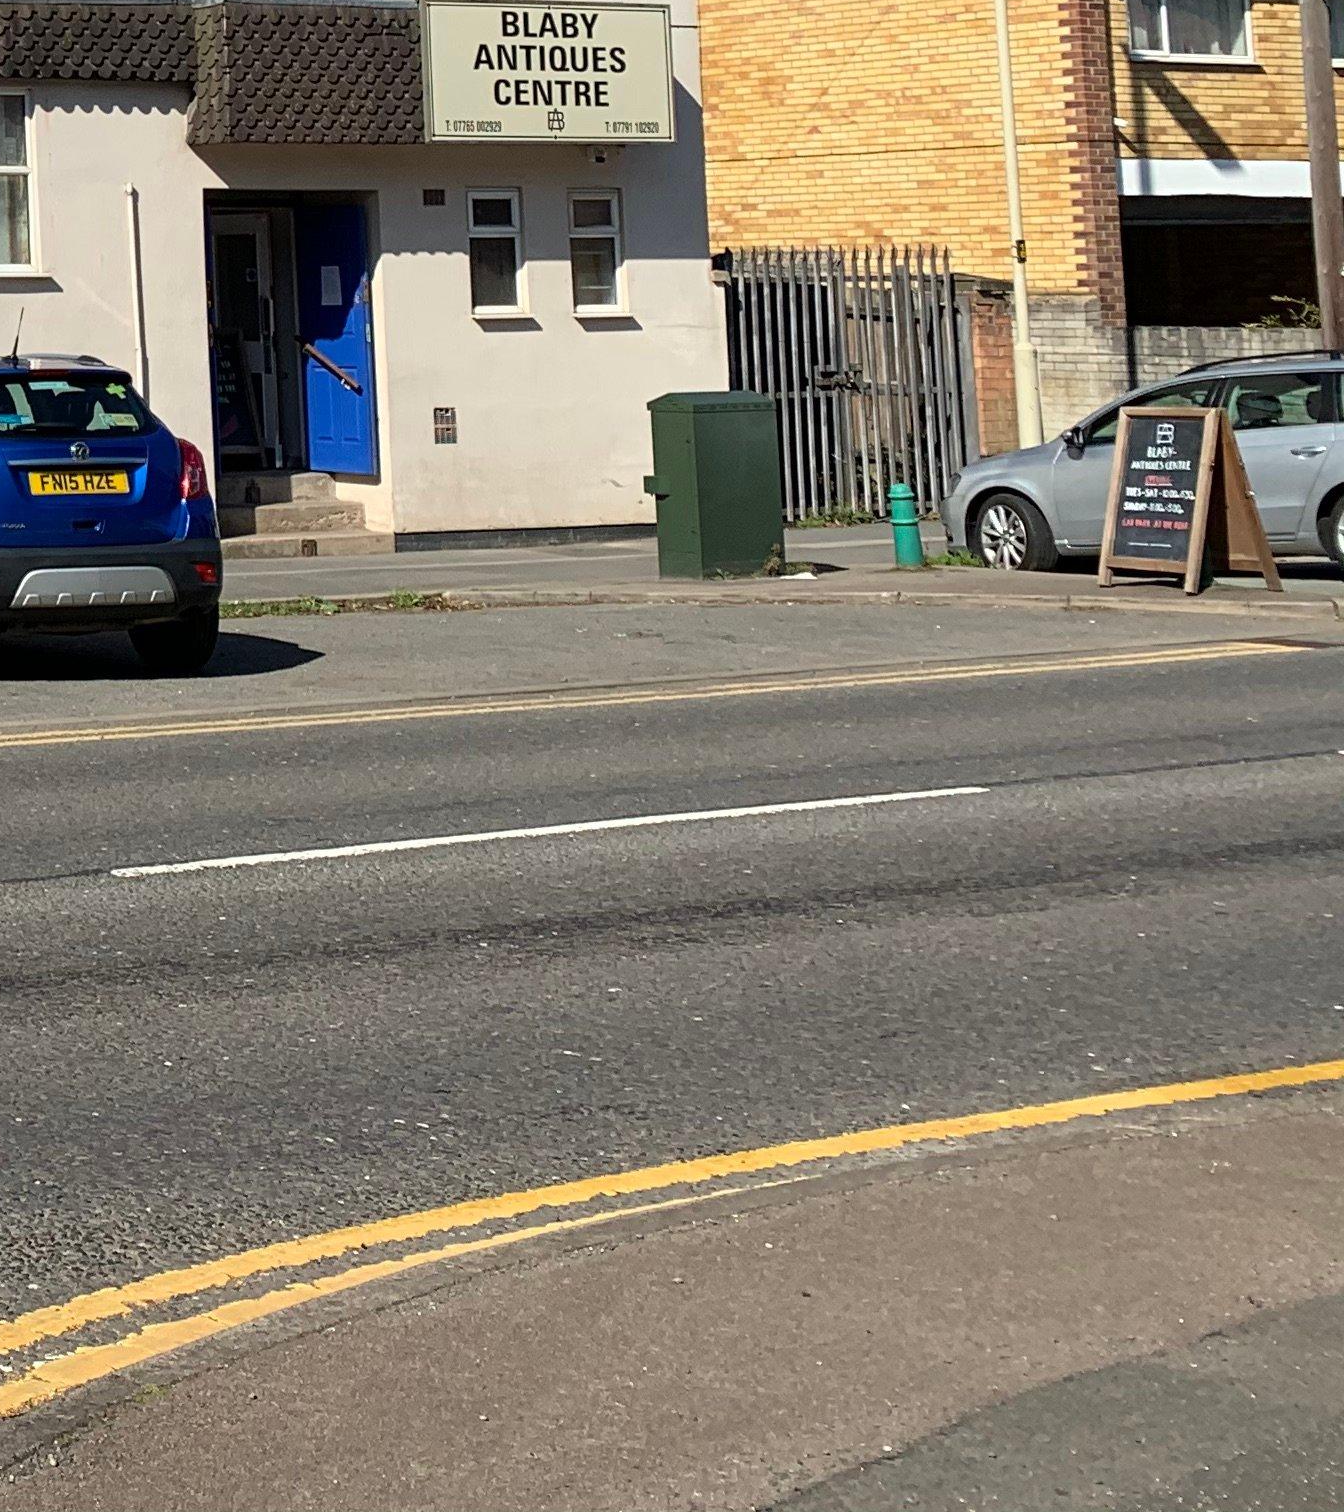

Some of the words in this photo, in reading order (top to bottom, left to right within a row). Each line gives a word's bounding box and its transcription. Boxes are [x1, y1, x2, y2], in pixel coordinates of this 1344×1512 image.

[501, 10, 599, 39] BLABY
[473, 44, 627, 73] ANTIQUES
[493, 79, 610, 107] CENTRE
[39, 473, 79, 492] FN15
[84, 472, 117, 491] HZE
